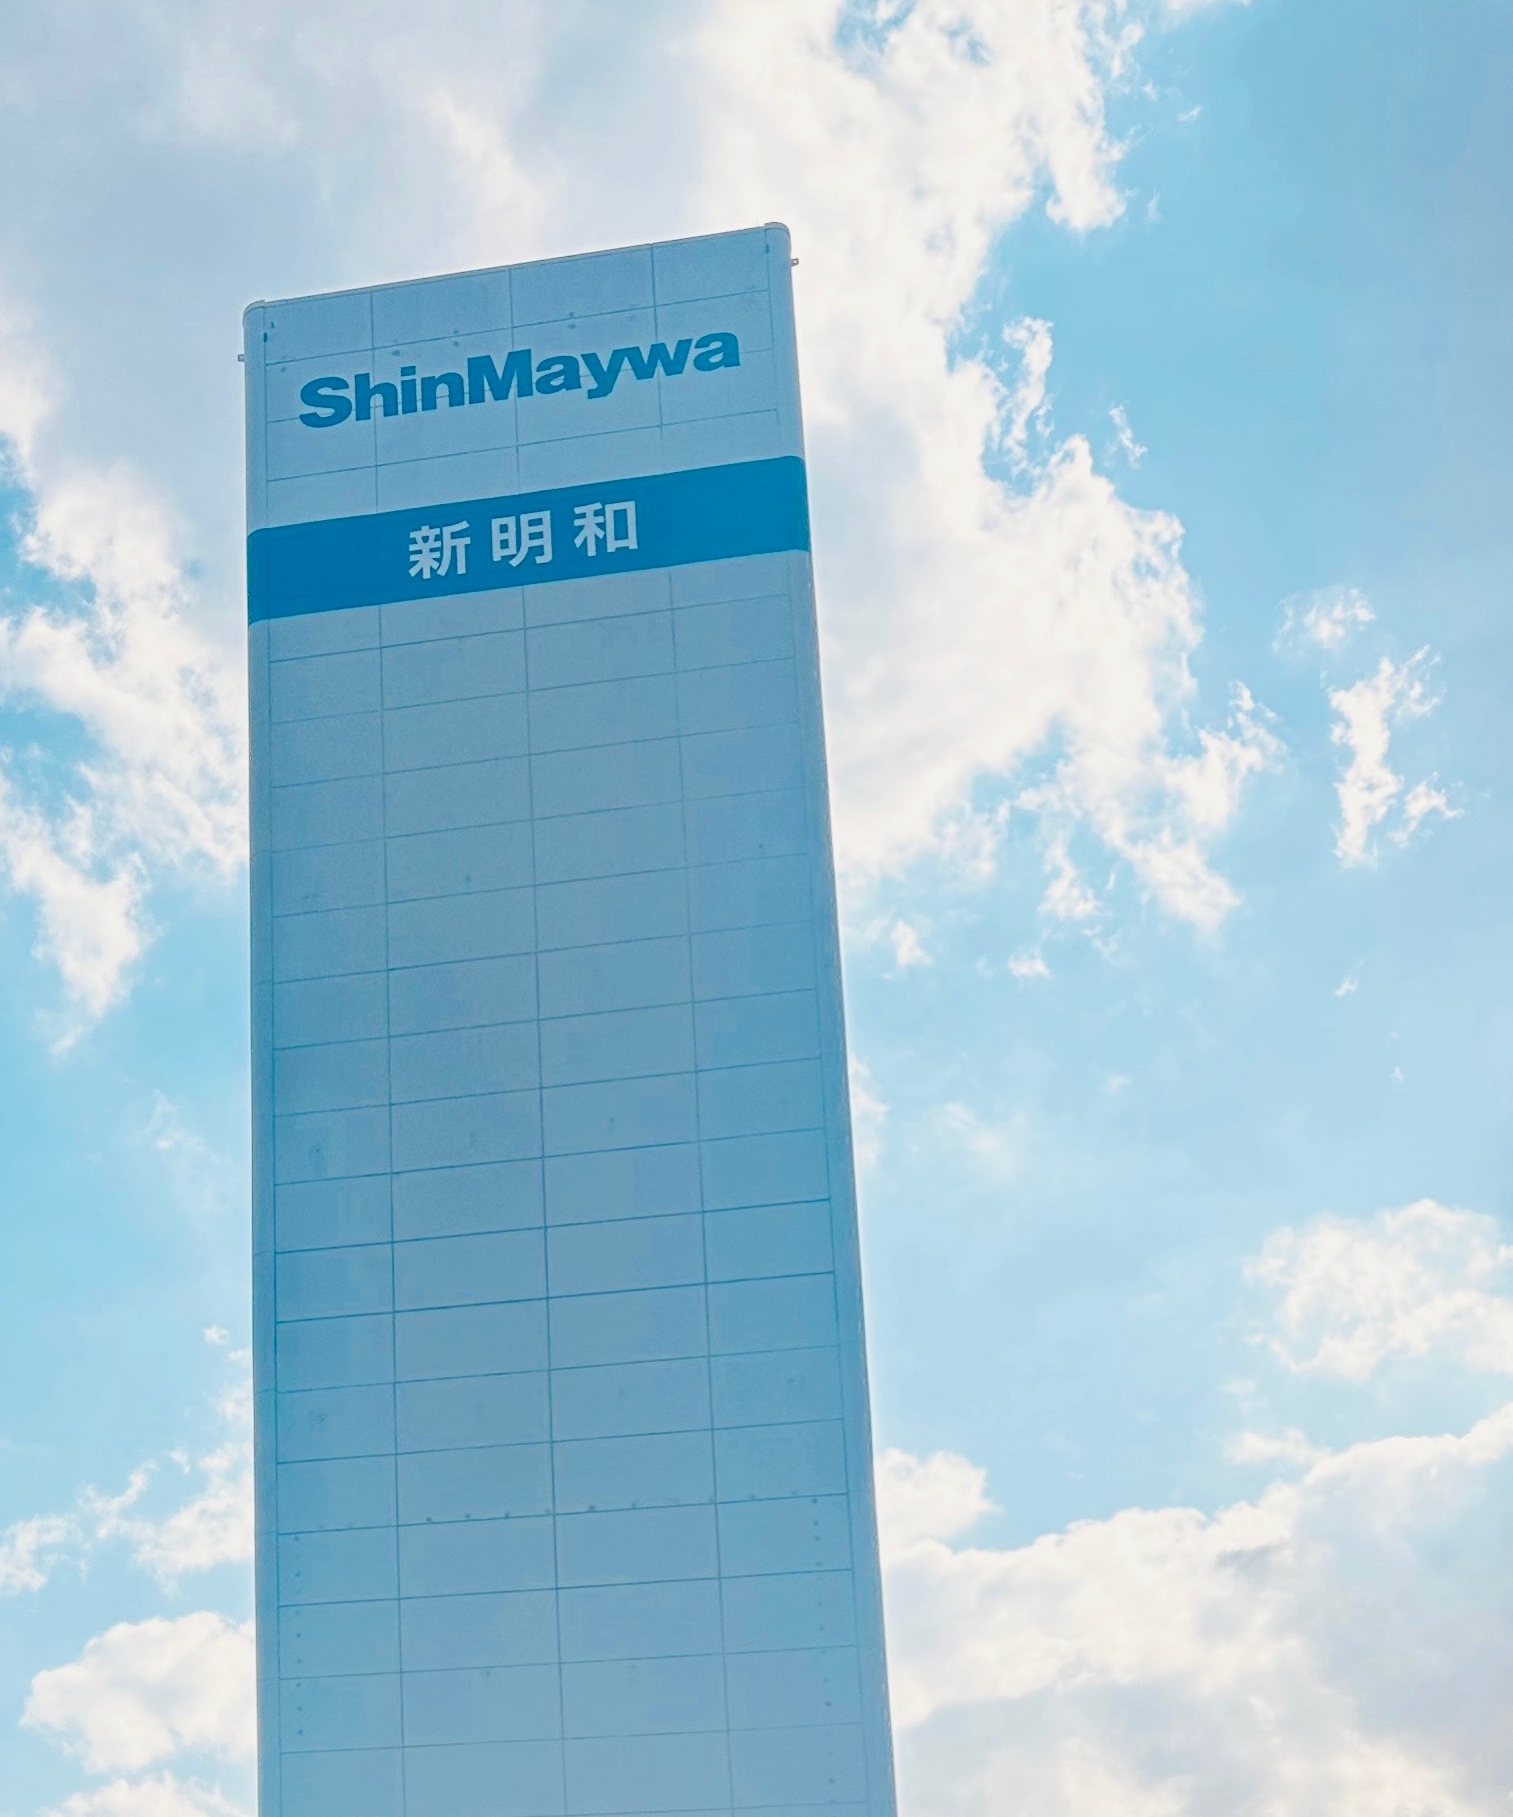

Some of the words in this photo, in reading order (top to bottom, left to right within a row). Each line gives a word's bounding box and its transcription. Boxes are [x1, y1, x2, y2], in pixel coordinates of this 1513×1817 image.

[299, 331, 740, 428] ShinMaywa
[409, 501, 639, 579] 新明和
